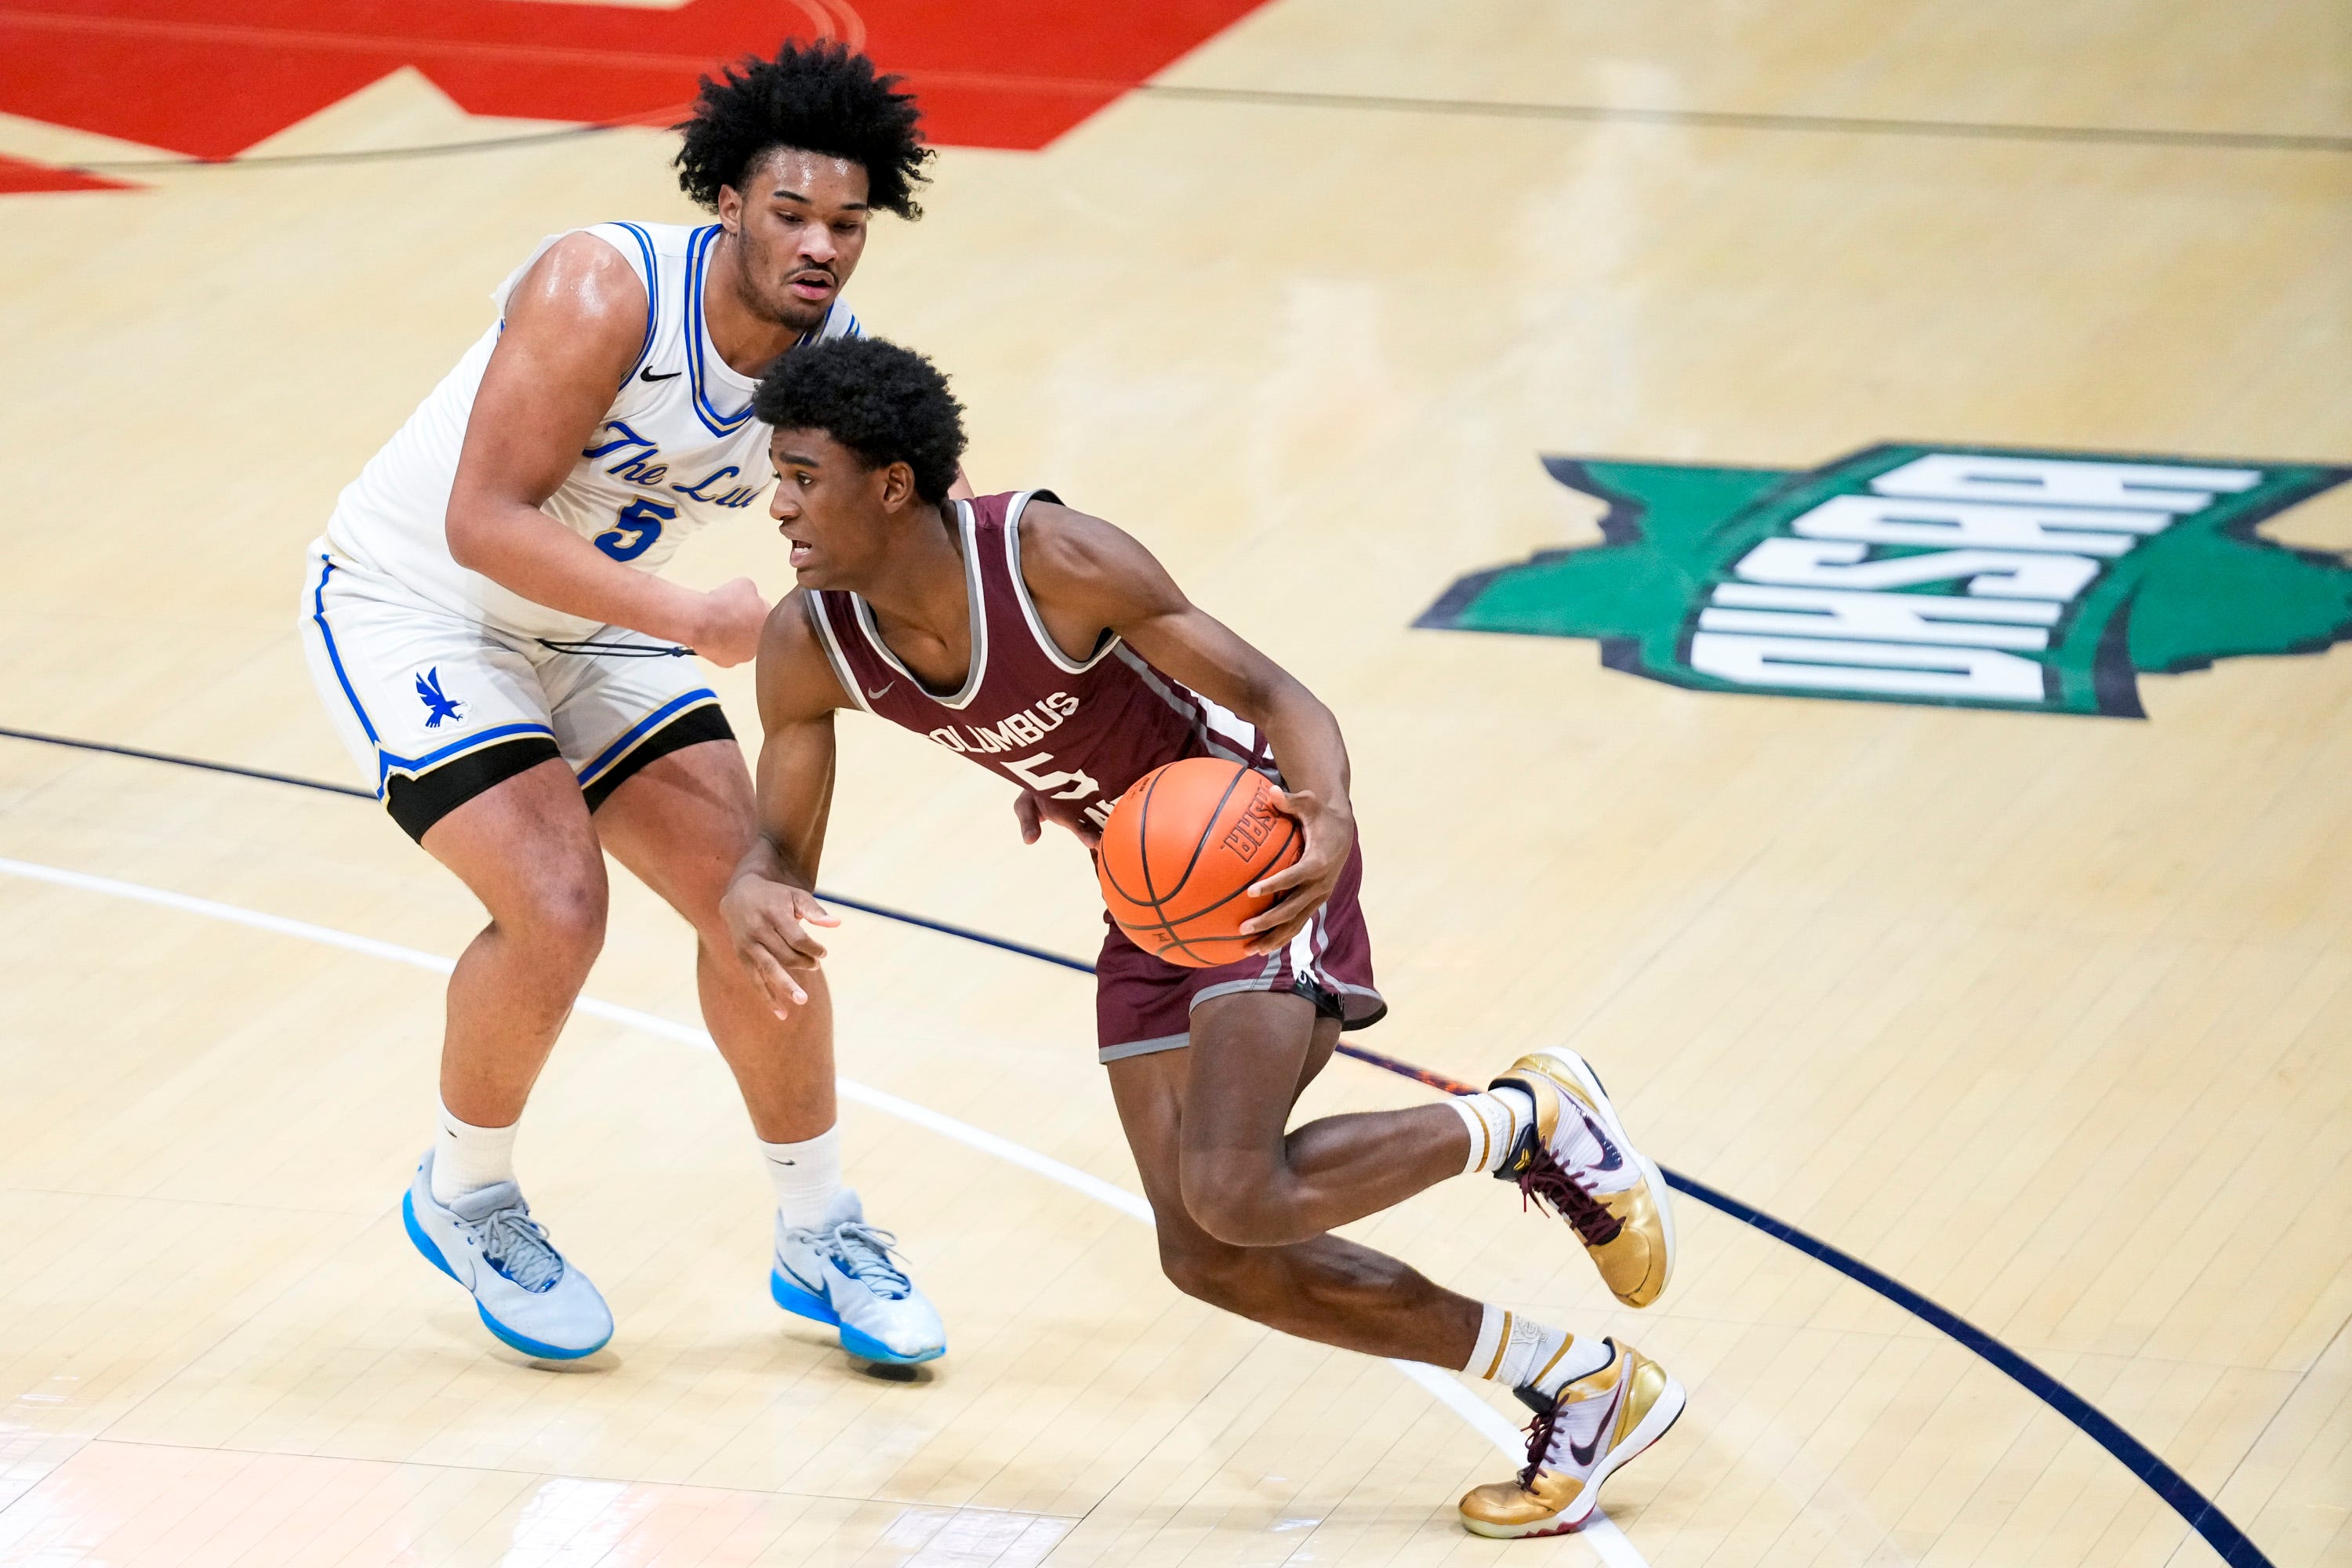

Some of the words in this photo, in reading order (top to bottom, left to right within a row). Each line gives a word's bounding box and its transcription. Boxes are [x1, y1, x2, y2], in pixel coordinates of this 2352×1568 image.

[581, 419, 668, 486] The
[592, 495, 679, 563] 5
[1691, 452, 2261, 702] OHSAA
[929, 691, 1080, 753] OLUMBUS
[1000, 751, 1100, 800] 5
